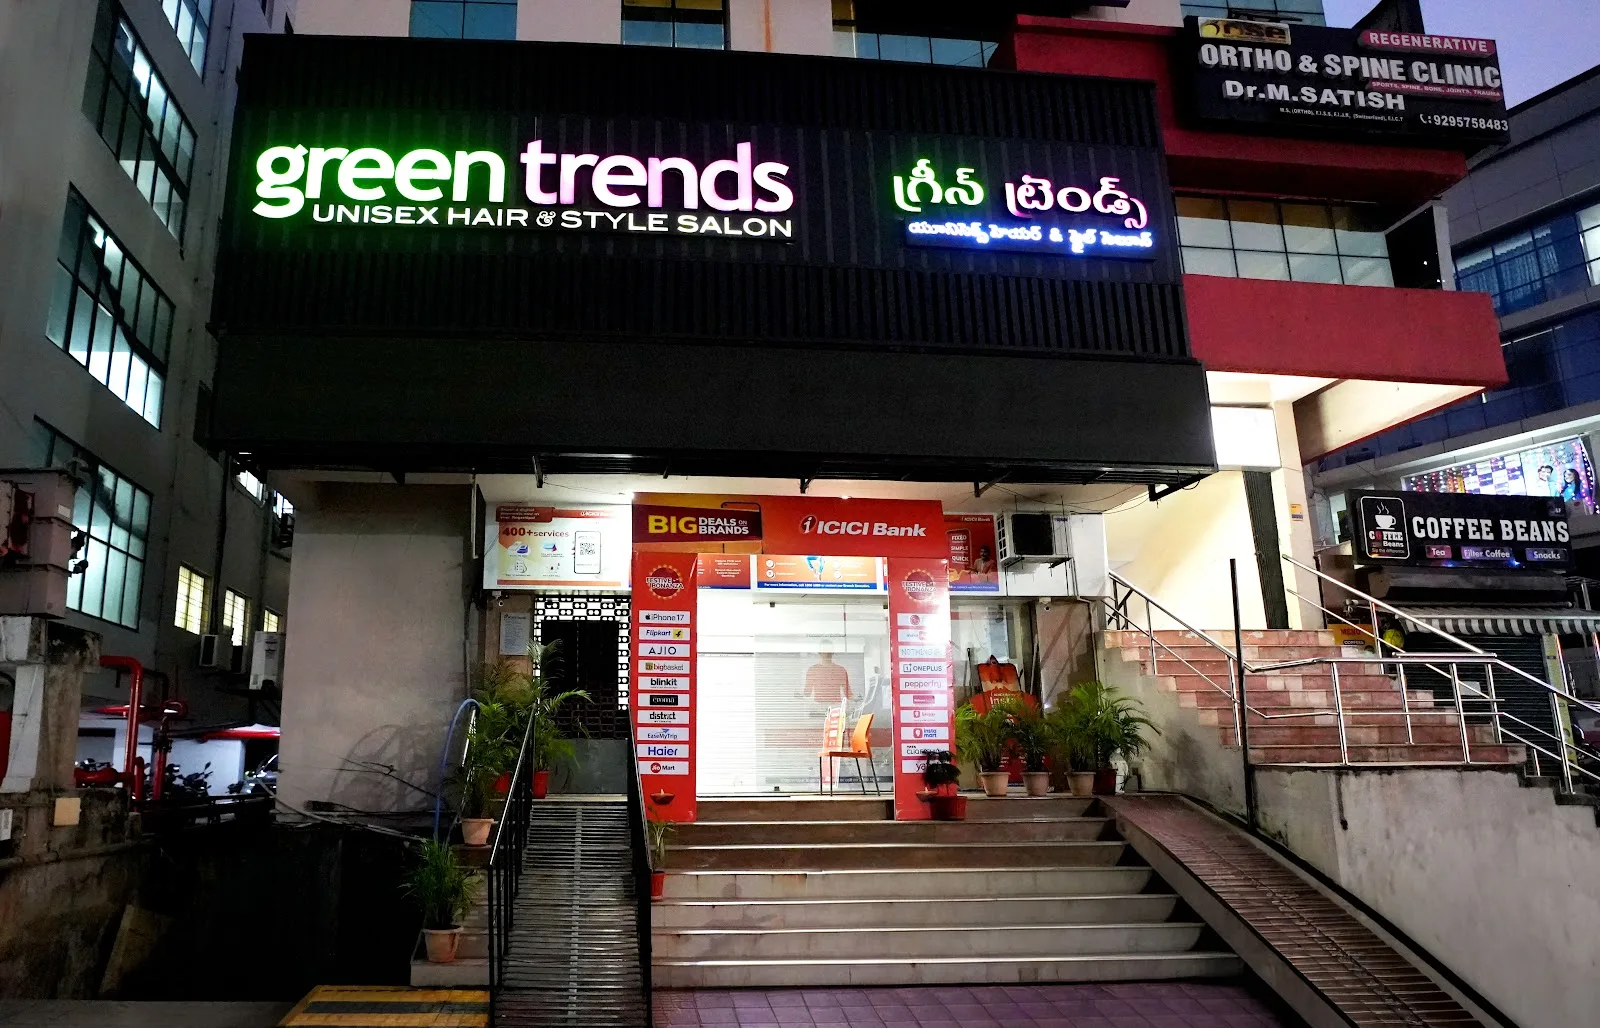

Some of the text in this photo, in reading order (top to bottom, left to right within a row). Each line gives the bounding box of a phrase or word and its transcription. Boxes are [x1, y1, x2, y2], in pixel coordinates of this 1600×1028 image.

[1369, 32, 1488, 52] REGENERATIVE
[1200, 43, 1500, 88] ORTHO & SPINE CLINIC
[1372, 81, 1400, 89] SPORTS,
[1474, 89, 1501, 97] TRAUMA
[252, 139, 795, 219] green trends
[893, 158, 1149, 229] గ్రీన్ ట్రెండ్స్
[312, 204, 793, 238] UNISEX HAIR & STYLE SALON
[1049, 227, 1064, 243] &
[648, 515, 698, 534] BIG
[698, 517, 737, 526] DEALS
[698, 525, 749, 535] BRANDS
[816, 524, 868, 536] ICICI
[873, 524, 926, 538] Bank
[1412, 516, 1570, 543] COFFEE BEANS
[1369, 530, 1403, 541] COFFEE
[1431, 548, 1560, 559] Tea Filter Coffee Snacks
[645, 629, 671, 637] Flipkart
[648, 646, 677, 655] AJIO
[650, 678, 678, 686] blinkit
[649, 712, 677, 720] district
[647, 746, 678, 756] Haier
